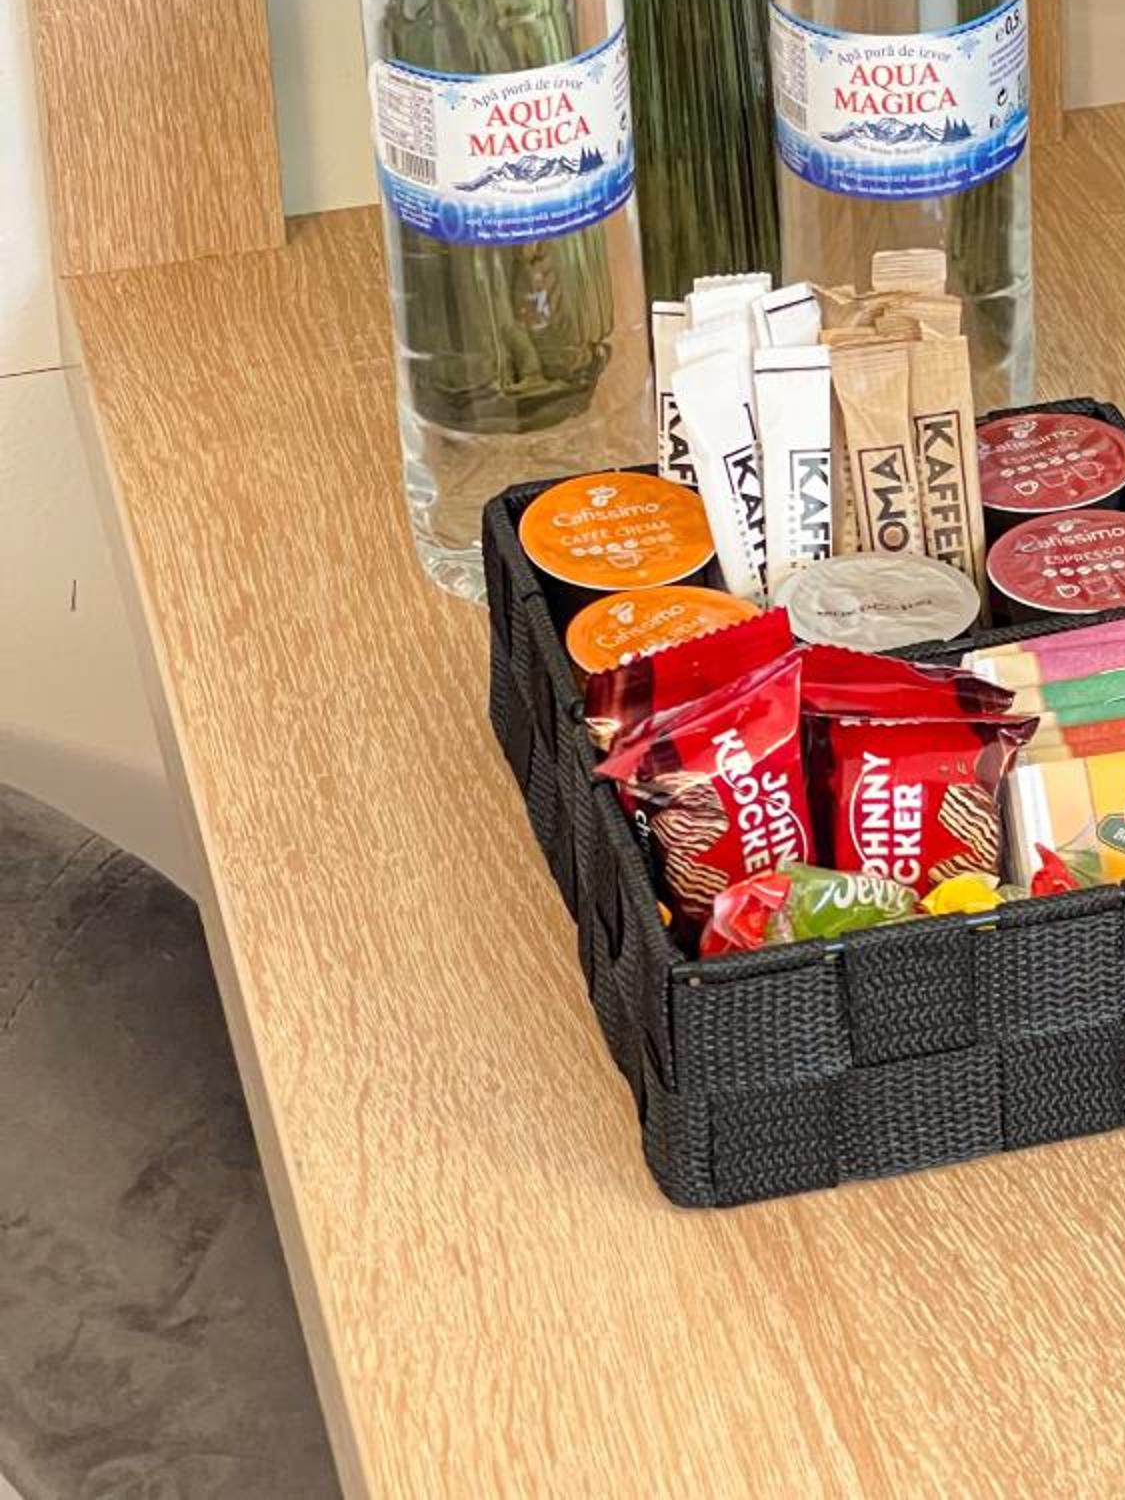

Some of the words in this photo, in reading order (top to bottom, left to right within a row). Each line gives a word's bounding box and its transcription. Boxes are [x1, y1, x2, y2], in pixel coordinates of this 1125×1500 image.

[898, 44, 915, 57] de
[535, 78, 551, 91] de
[849, 61, 940, 92] AQUA
[486, 91, 576, 128] AQUA
[833, 85, 958, 115] MAGICA
[468, 114, 592, 157] MAGICA
[552, 502, 660, 528] Cafissimo
[798, 457, 831, 561] KAFF
[1018, 527, 1125, 553] Cafissimo
[1043, 545, 1125, 566] ESPRESSO
[710, 728, 772, 874] KROCKE
